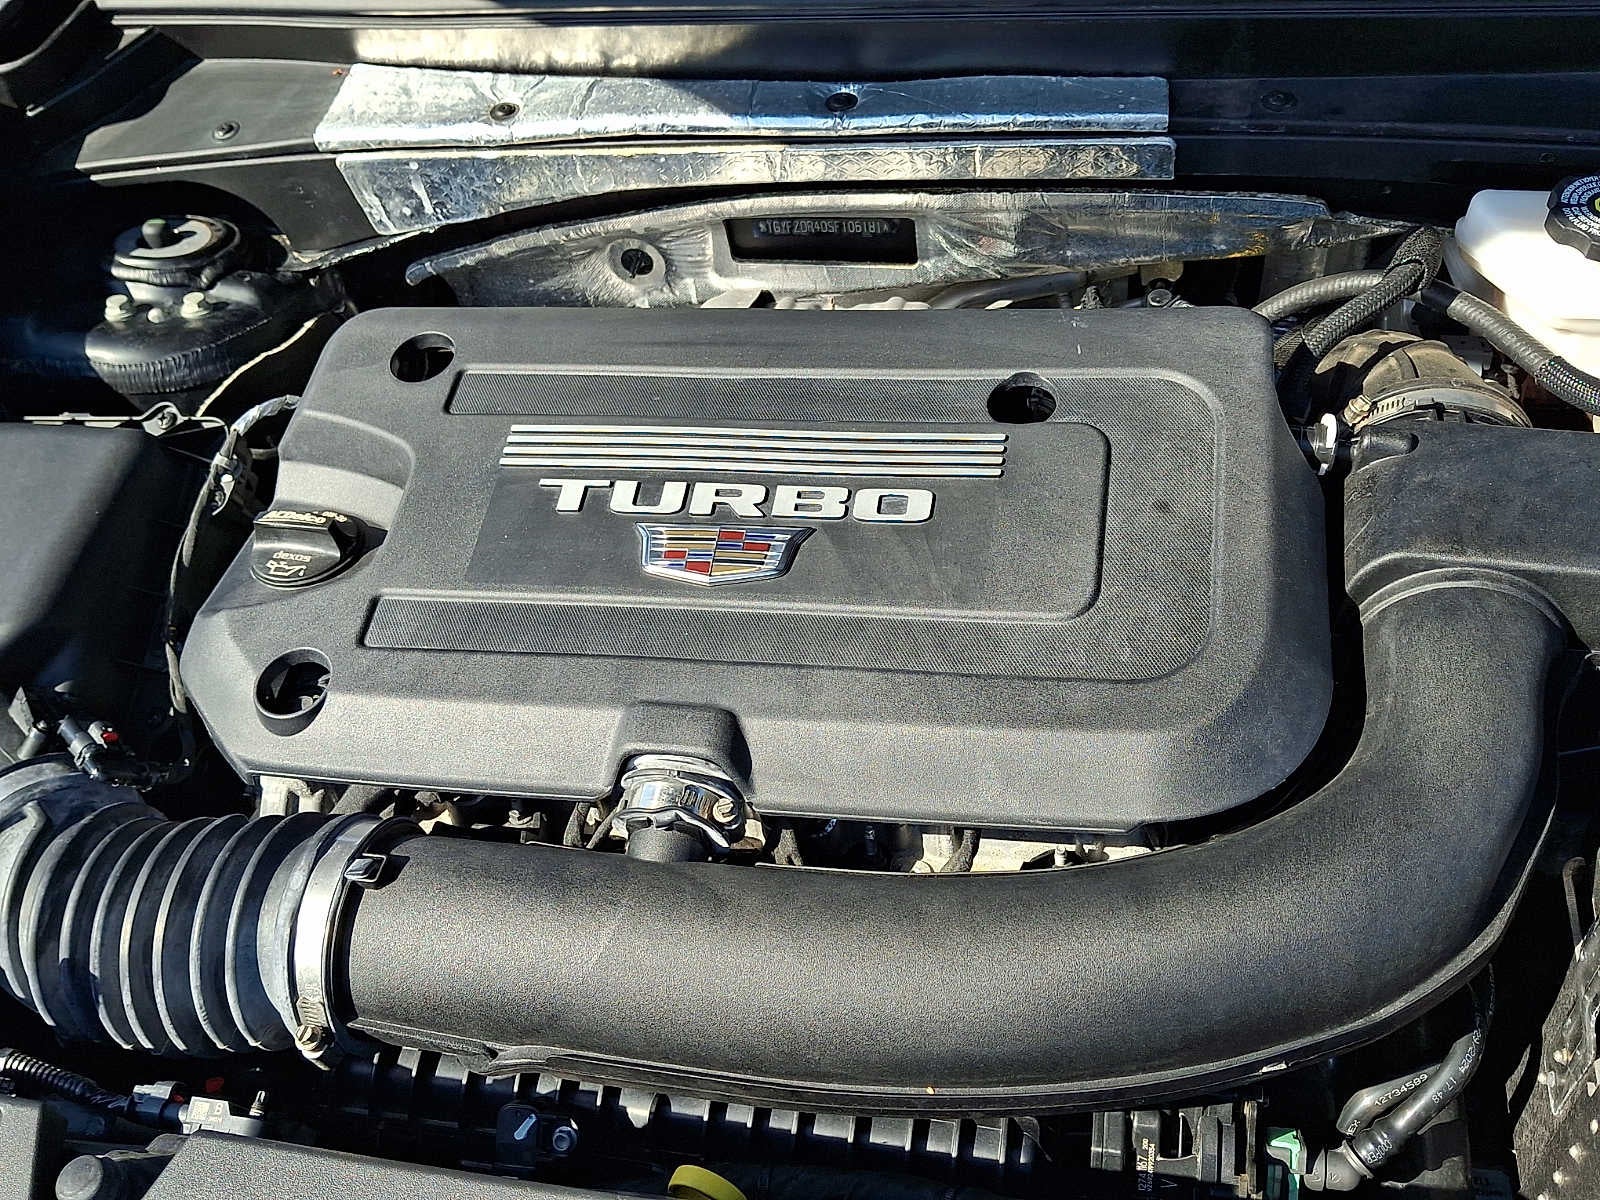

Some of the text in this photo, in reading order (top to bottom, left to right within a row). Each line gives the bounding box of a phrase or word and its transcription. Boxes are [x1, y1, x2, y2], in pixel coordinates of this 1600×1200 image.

[538, 478, 937, 524] TURBO
[272, 551, 312, 563] dexos
[1374, 1073, 1429, 1107] 12734589
[1366, 1137, 1393, 1164] COOPER
